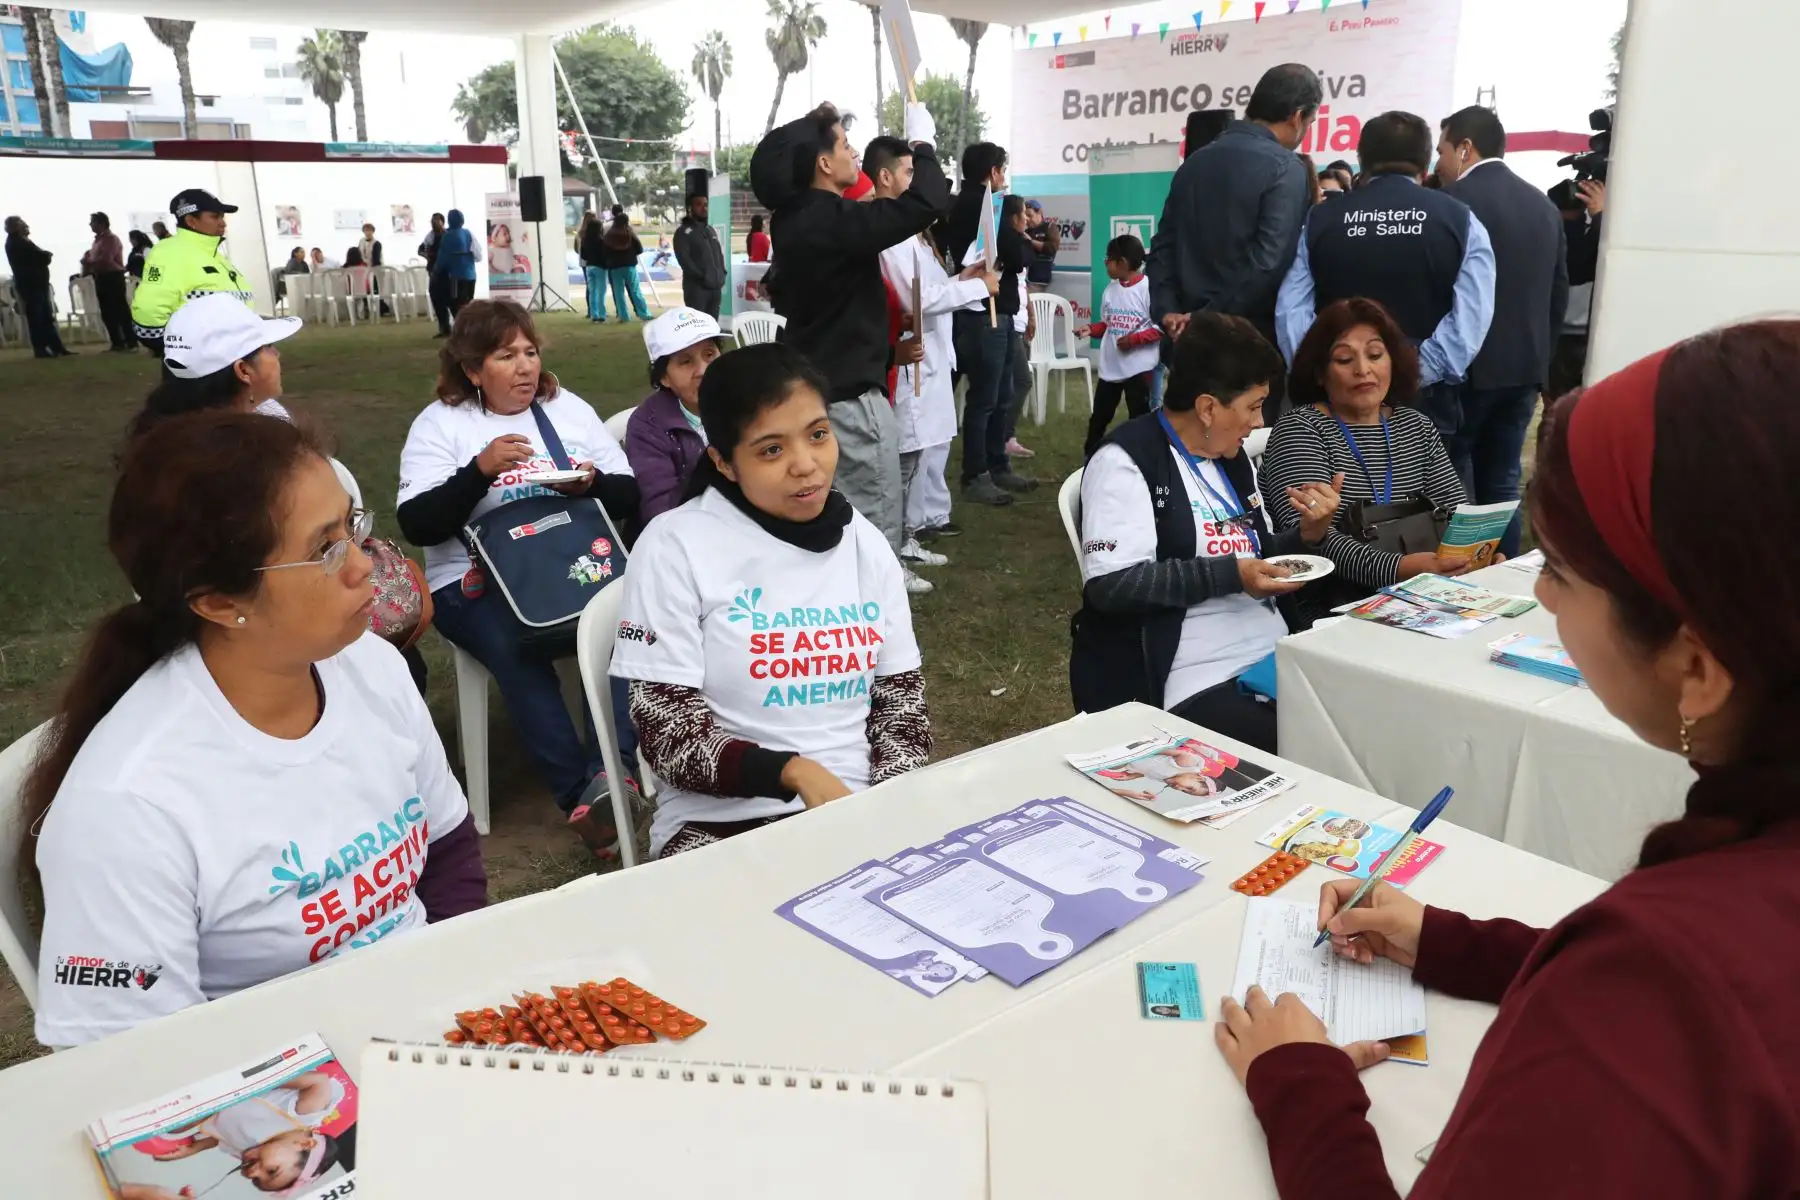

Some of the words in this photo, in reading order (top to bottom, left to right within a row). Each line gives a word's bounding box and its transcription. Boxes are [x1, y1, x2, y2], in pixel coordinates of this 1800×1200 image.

[1062, 83, 1213, 120] Barranco
[1220, 85, 1251, 108] se
[1343, 207, 1427, 224] Ministerio
[1347, 224, 1367, 237] de
[1376, 223, 1422, 236] Salud
[749, 632, 785, 655] SE
[792, 626, 884, 653] ACTIVA
[749, 652, 861, 680] CONTRA
[866, 650, 878, 671] L
[762, 675, 868, 708] ANEMIA
[301, 888, 348, 935] SE
[66, 955, 105, 968] amor
[117, 960, 130, 969] de
